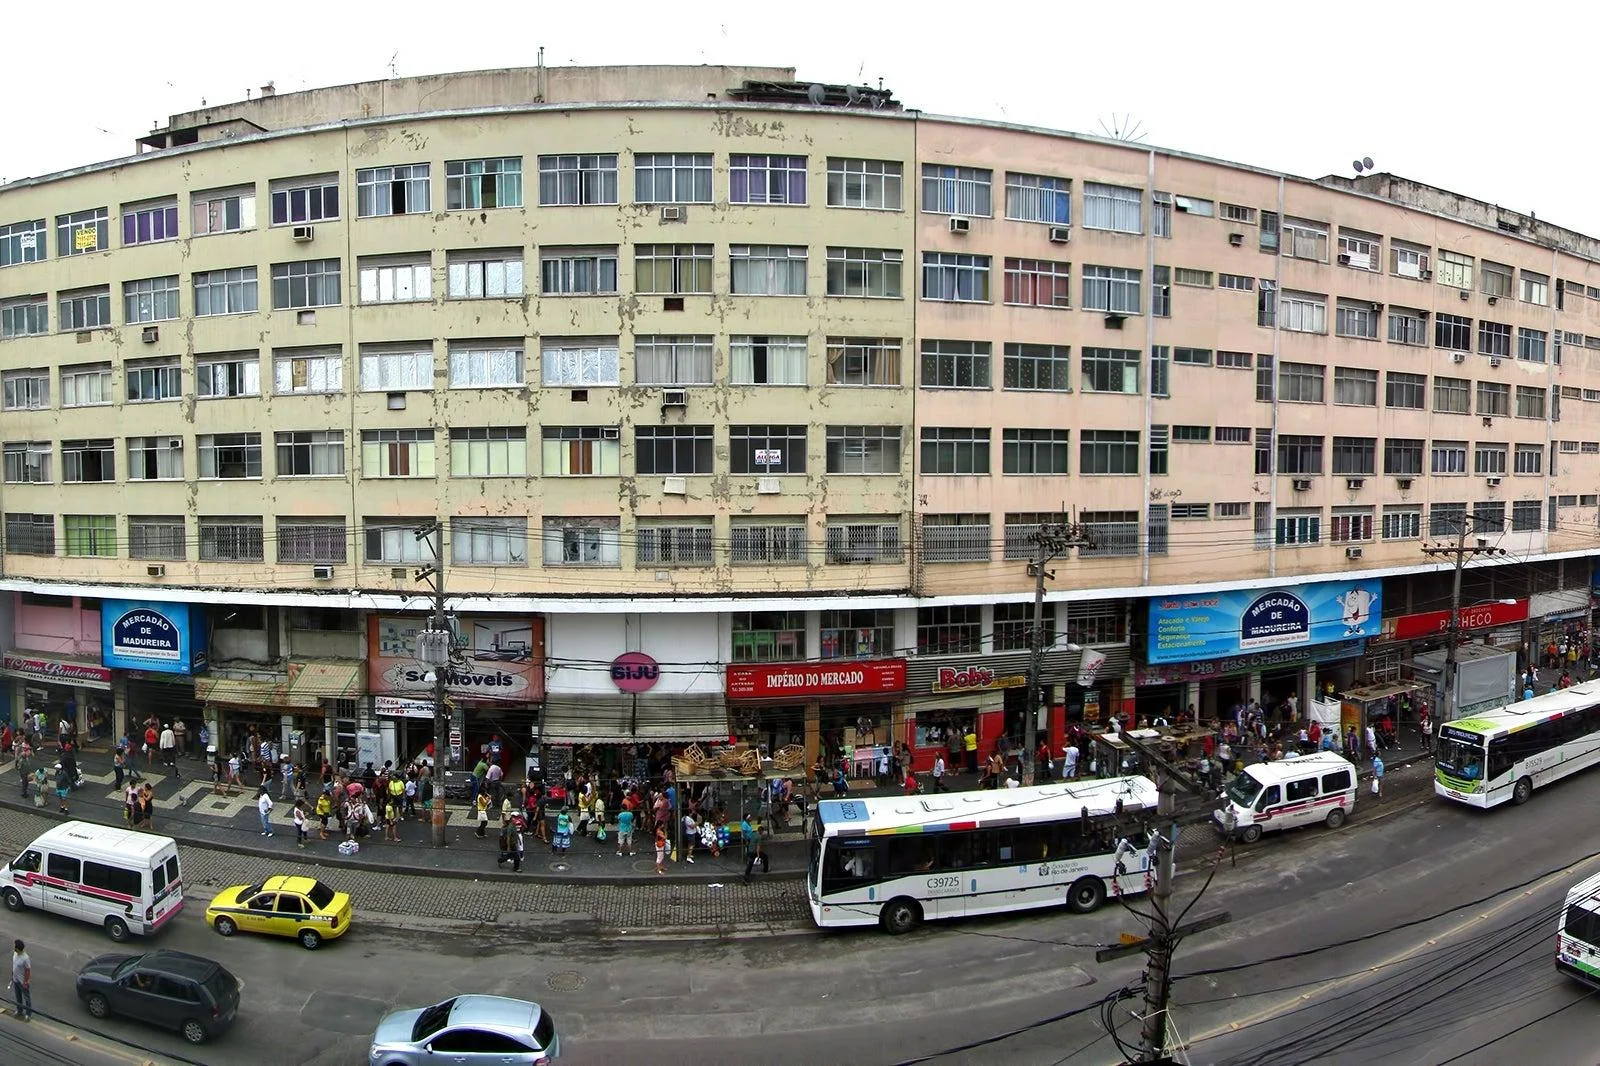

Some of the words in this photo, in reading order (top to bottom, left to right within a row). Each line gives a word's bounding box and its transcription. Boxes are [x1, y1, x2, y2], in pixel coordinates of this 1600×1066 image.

[1251, 599, 1300, 617] MERCADÃO
[1158, 616, 1184, 624] Atacado
[1271, 612, 1283, 620] DE
[122, 615, 169, 631] MERCADÃO
[1251, 622, 1302, 635] MADUREIRA
[122, 637, 171, 648] MADUREIRA
[1157, 640, 1206, 650] Estacionamento
[1190, 662, 1216, 675] Dia
[1220, 658, 1247, 672] das
[766, 671, 804, 688] IMPÉRIO
[805, 673, 819, 687] DO
[820, 671, 864, 686] MERCADO
[939, 666, 994, 690] Bob's
[927, 876, 960, 889] C39725
